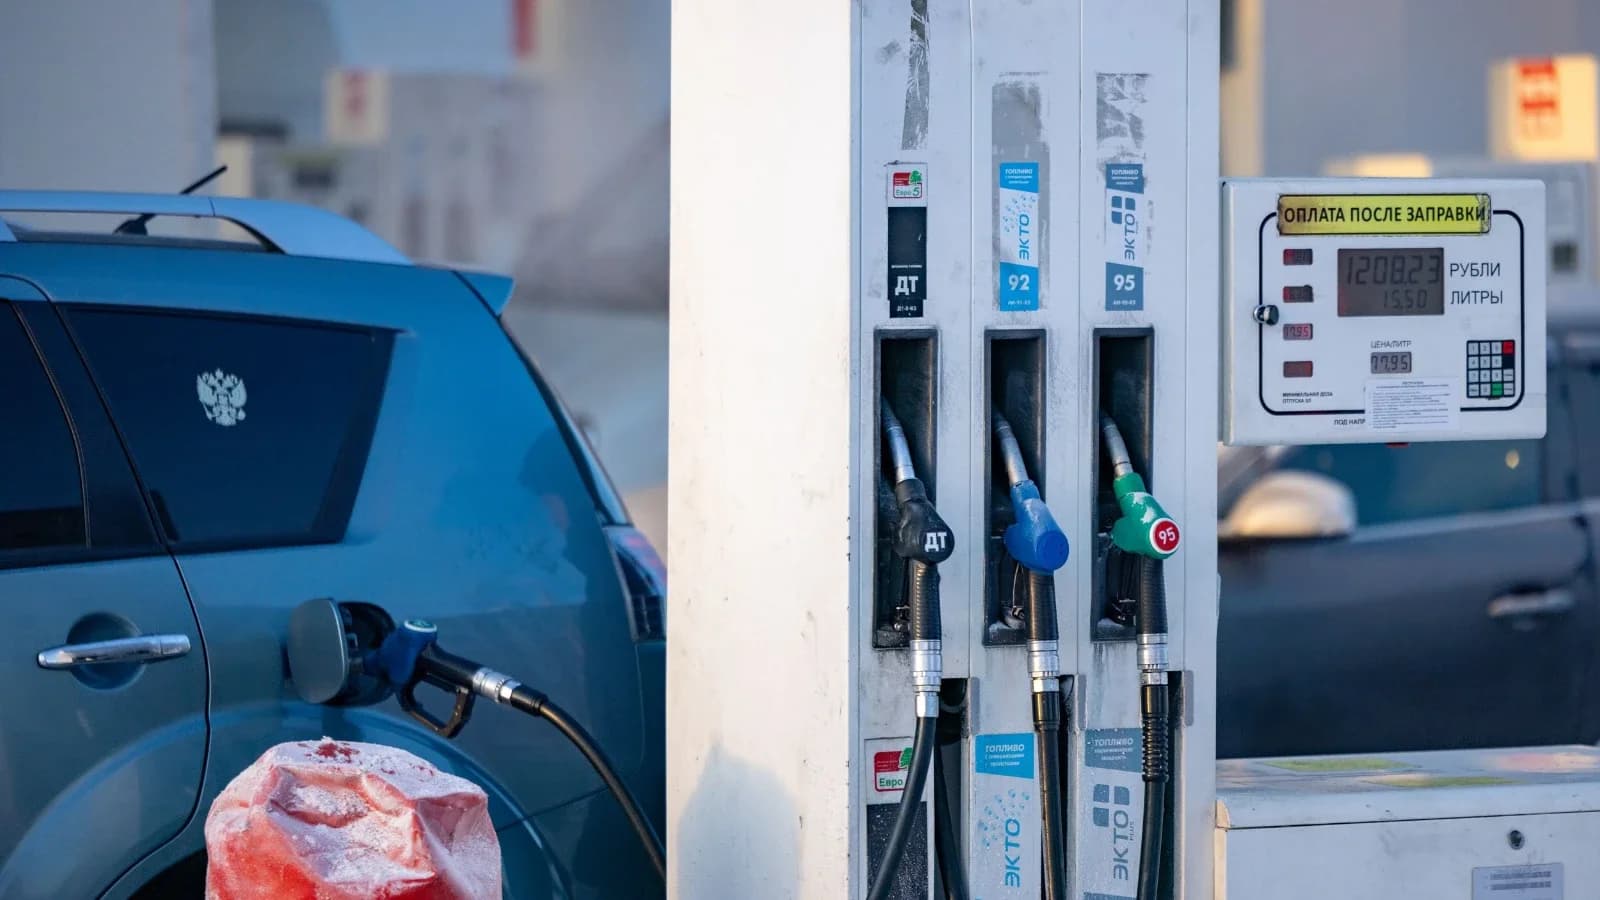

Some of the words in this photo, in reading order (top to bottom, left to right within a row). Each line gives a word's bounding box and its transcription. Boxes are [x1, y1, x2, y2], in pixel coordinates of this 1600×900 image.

[912, 187, 921, 197] 5
[1284, 207, 1345, 223] ОПЛАТА
[1350, 207, 1402, 222] ПОСЛЕ
[1406, 206, 1486, 222] ЗАПРАВКИ
[1019, 213, 1030, 261] ЭКТО
[1124, 213, 1136, 261] ЭКТО
[1449, 262, 1501, 278] РУБЛИ
[894, 275, 919, 296] ДТ
[1008, 274, 1030, 291] 92
[1113, 274, 1136, 291] 95
[1450, 290, 1503, 305] ЛИТРЫ
[925, 532, 947, 552] ДТ
[1158, 526, 1176, 544] 95
[985, 743, 1025, 753] ТОПЛИВО
[1094, 737, 1134, 746] ТОПЛИВО
[879, 777, 903, 788] Евро
[1004, 818, 1021, 889] ЭКТО
[1112, 809, 1129, 881] ЭКТО
